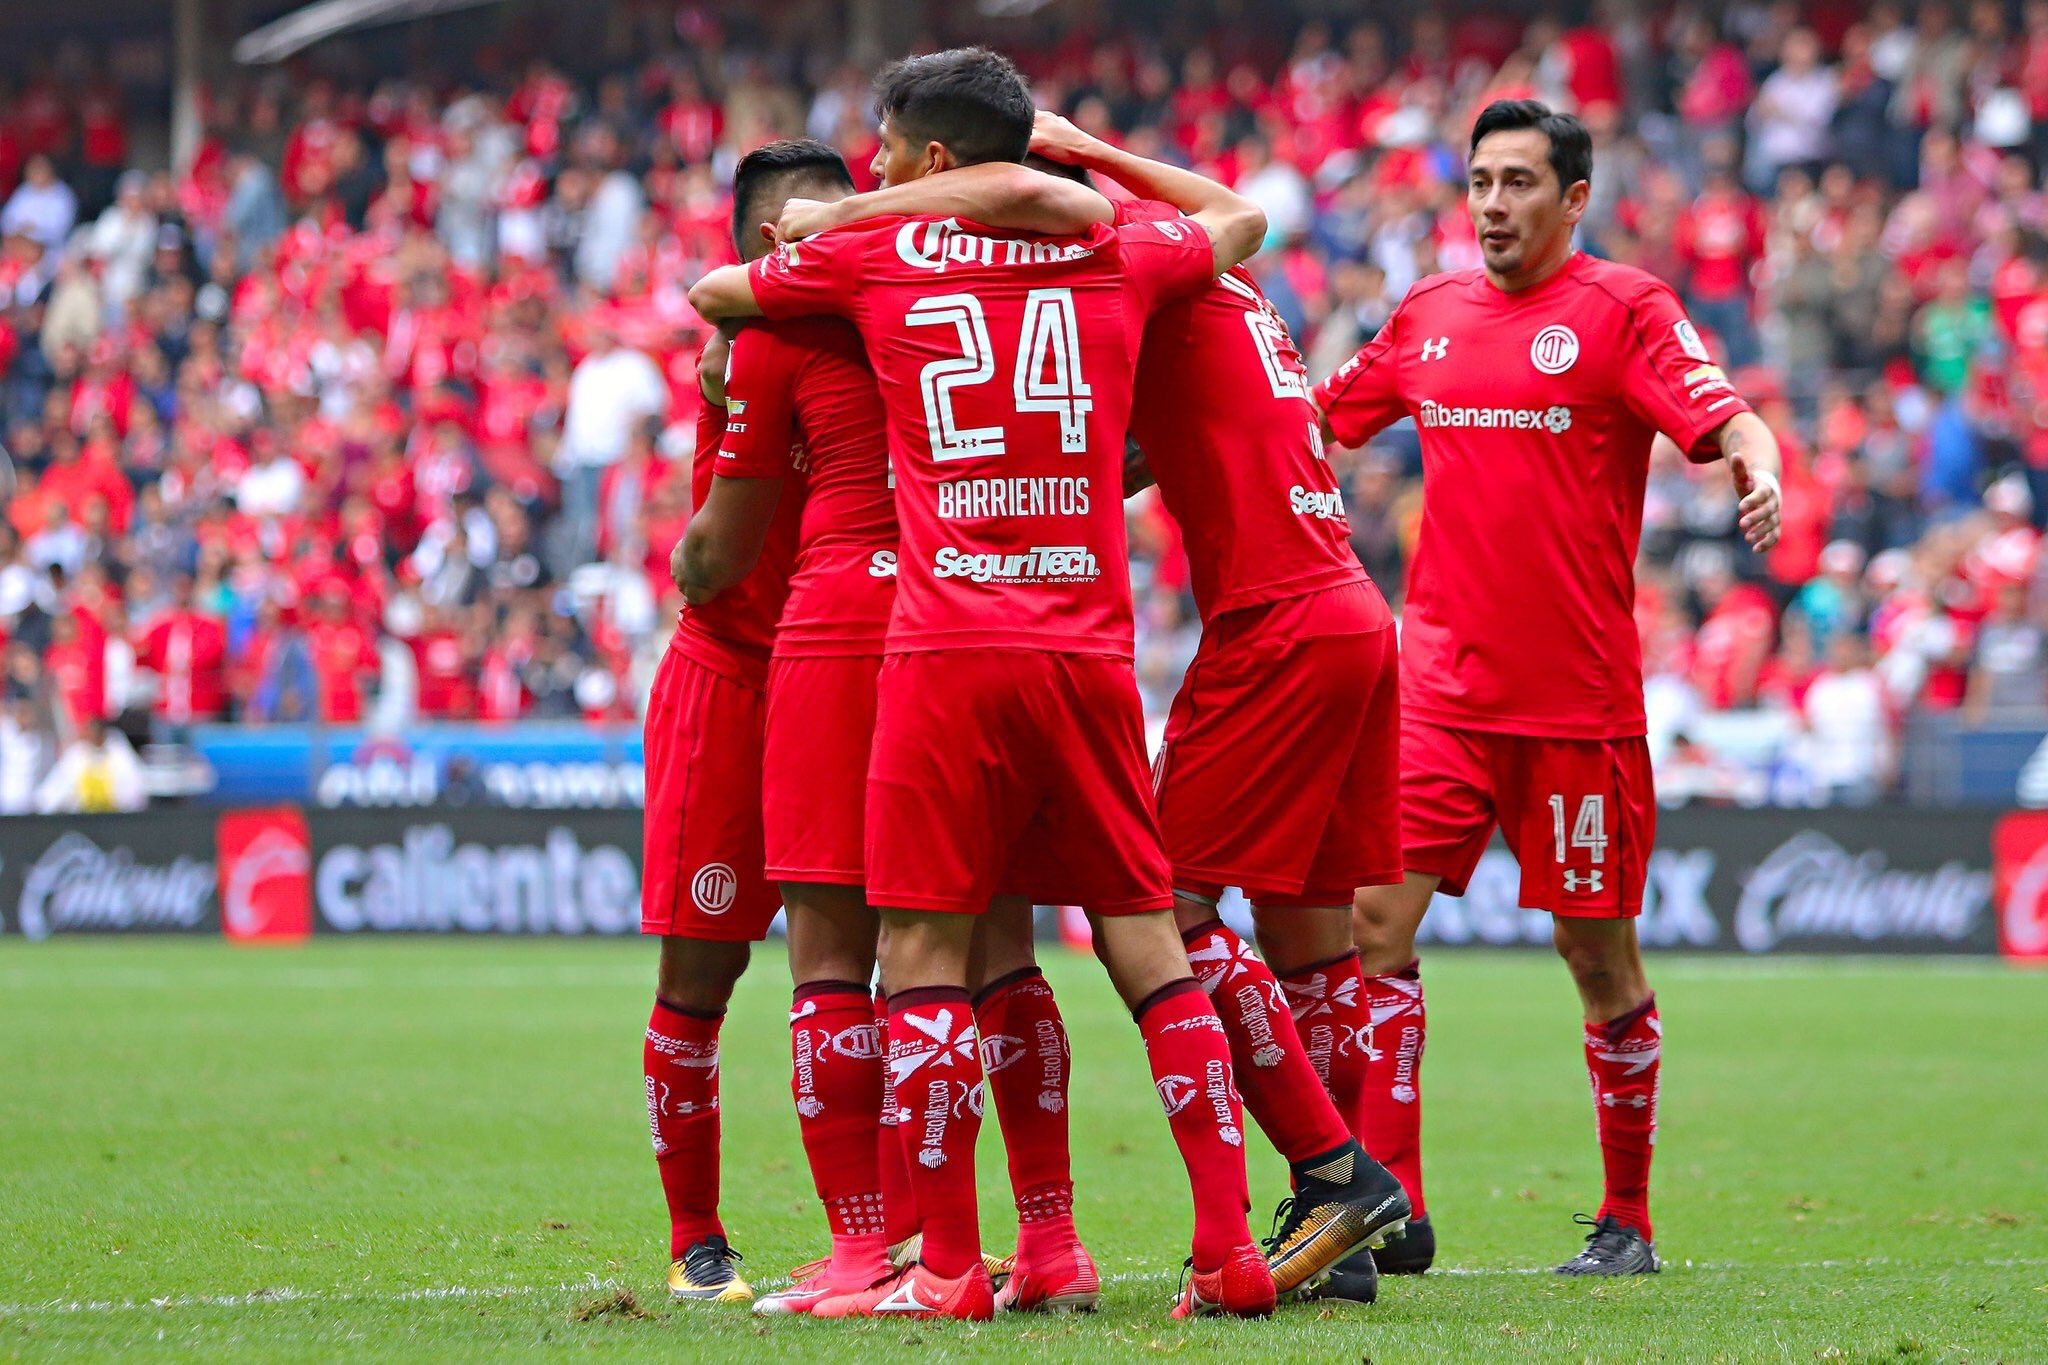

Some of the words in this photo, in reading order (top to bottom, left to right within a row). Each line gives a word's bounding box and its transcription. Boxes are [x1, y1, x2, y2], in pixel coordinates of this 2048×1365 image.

[905, 287, 1093, 463] 24
[937, 477, 1089, 518] BARRIENTOS
[933, 546, 1097, 583] SeguriTech
[1547, 794, 1609, 864] 14
[922, 1079, 950, 1146] AEROMEXICO
[1205, 1059, 1234, 1124] AEROMEXICO
[1363, 1194, 1398, 1226] MERCURIAL
